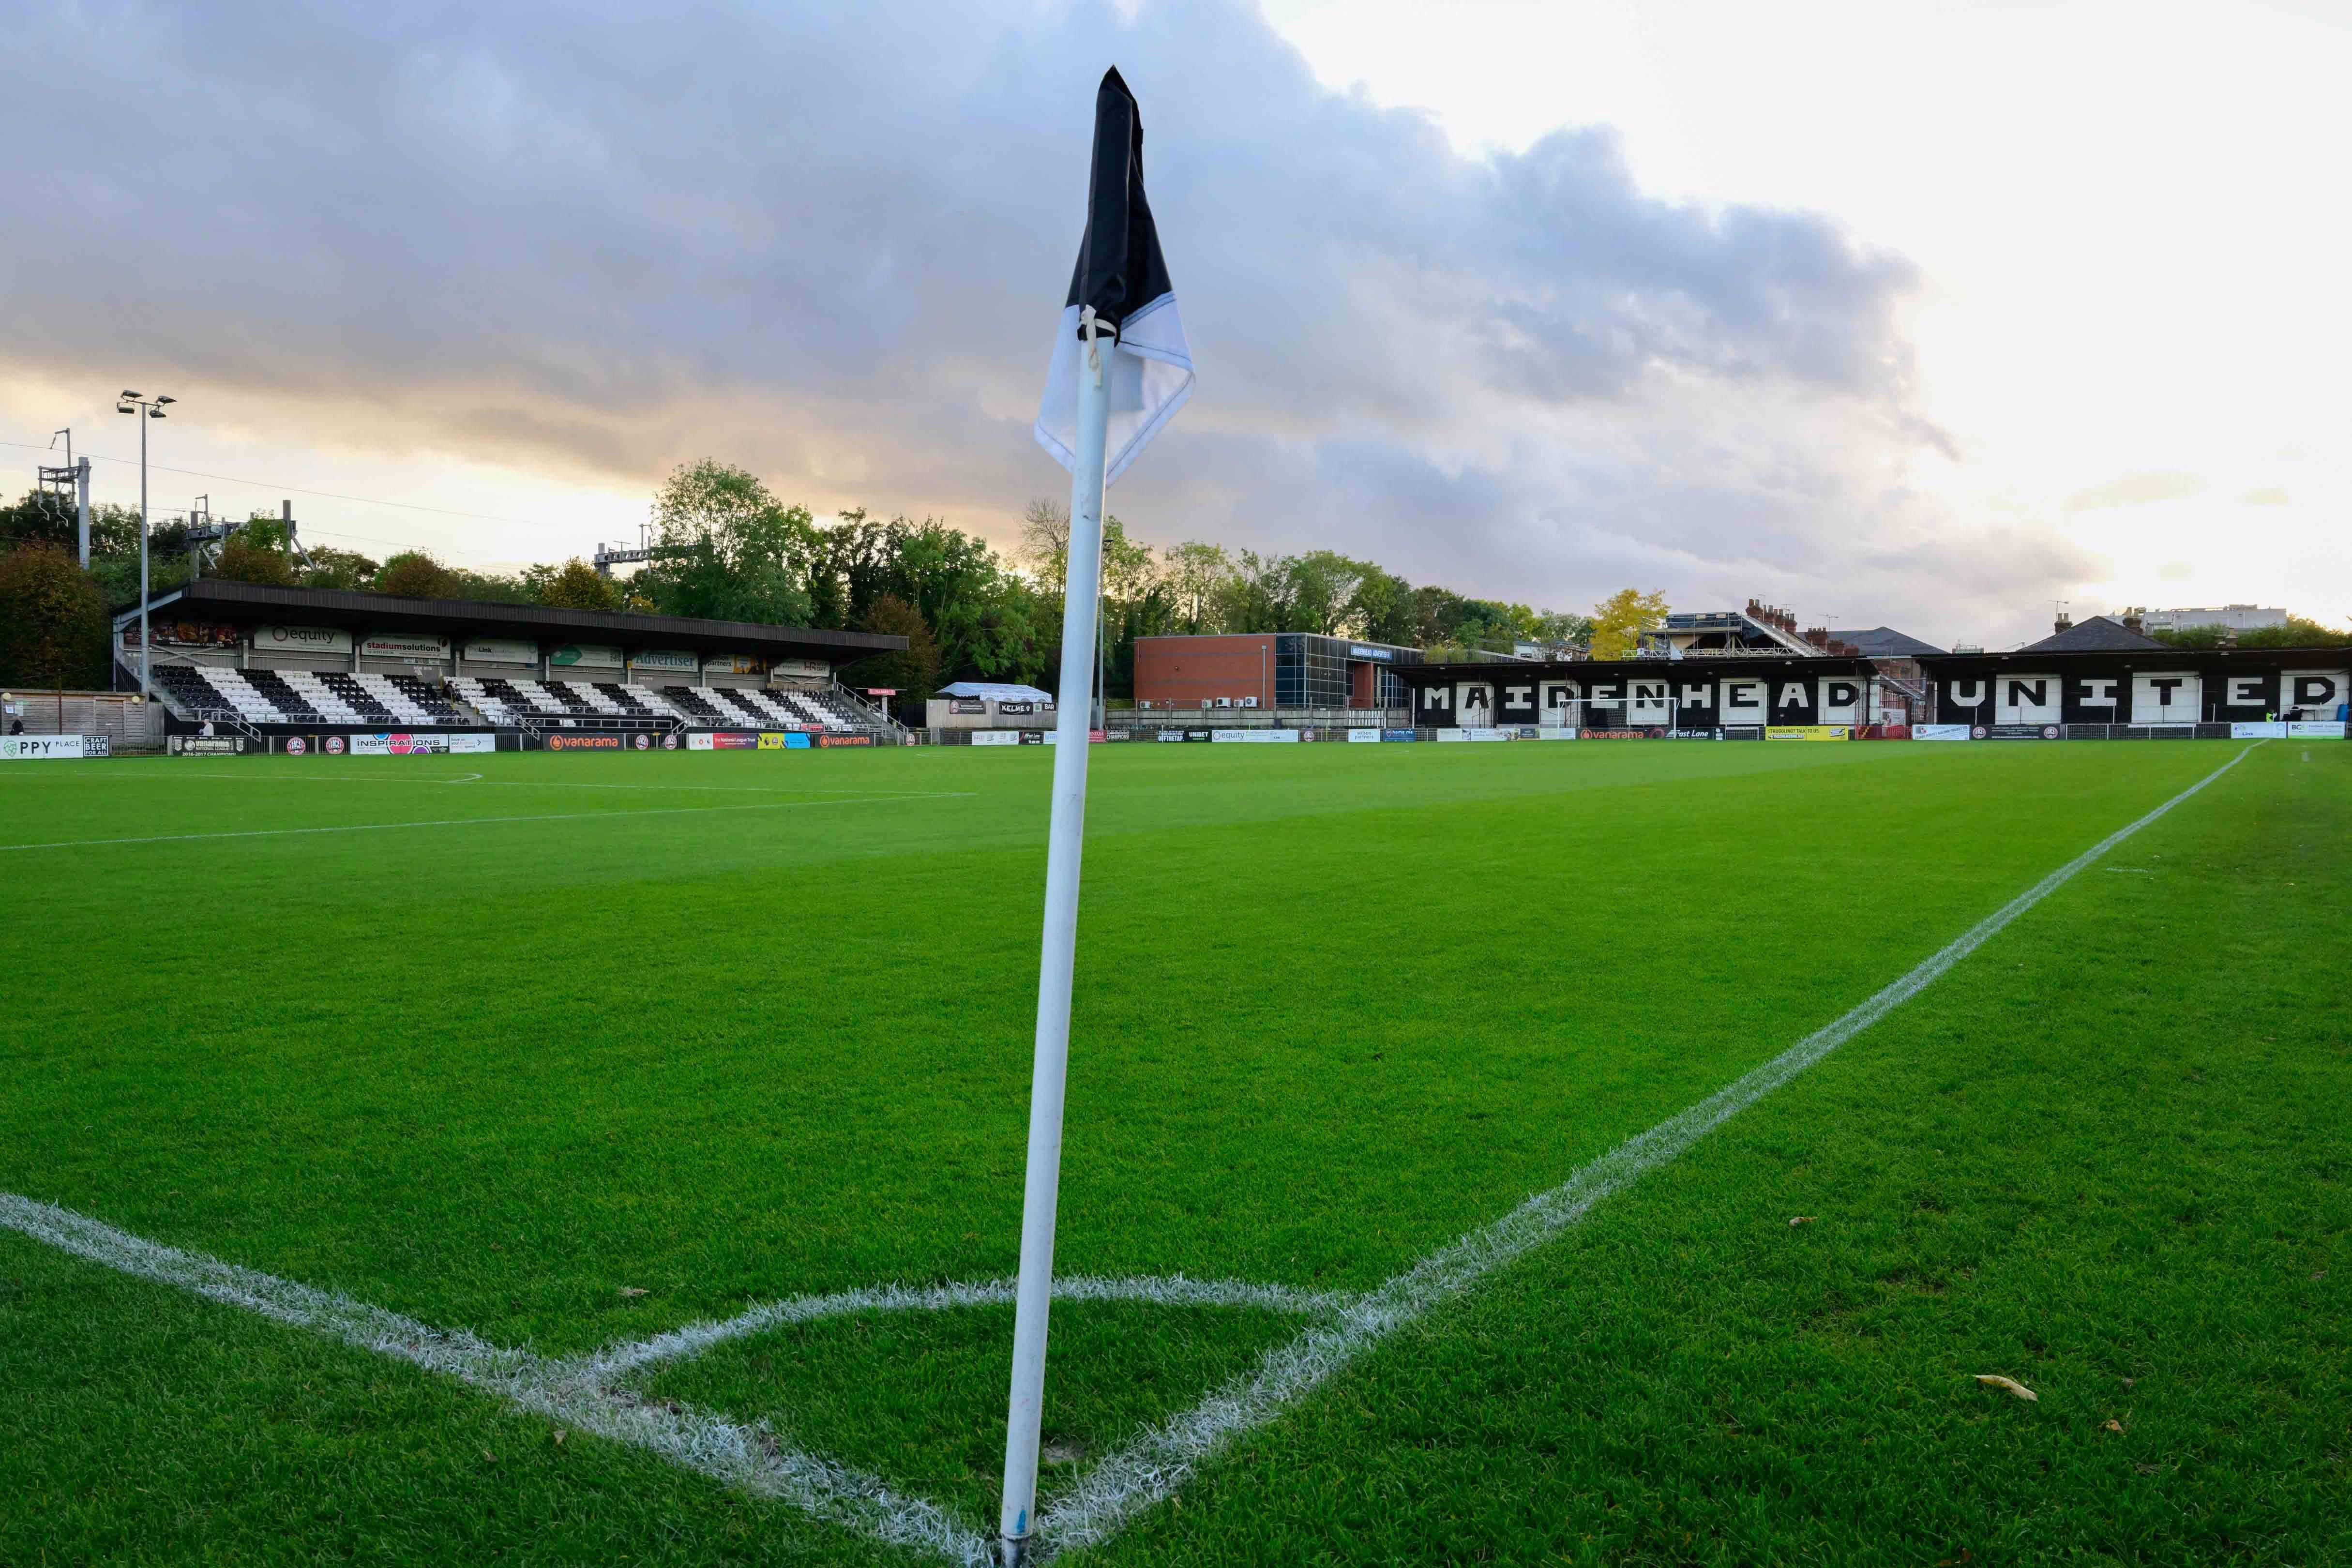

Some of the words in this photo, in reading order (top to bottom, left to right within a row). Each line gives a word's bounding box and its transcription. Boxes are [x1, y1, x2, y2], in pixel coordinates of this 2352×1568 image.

[290, 629, 335, 643] equity
[367, 642, 440, 651] stadiumsolutions
[635, 653, 693, 666] Advertiser
[1424, 683, 1859, 709] MAIDENHEAD
[1951, 677, 2335, 707] UNITED
[565, 738, 618, 747] vanarama
[1221, 732, 1244, 740] equity
